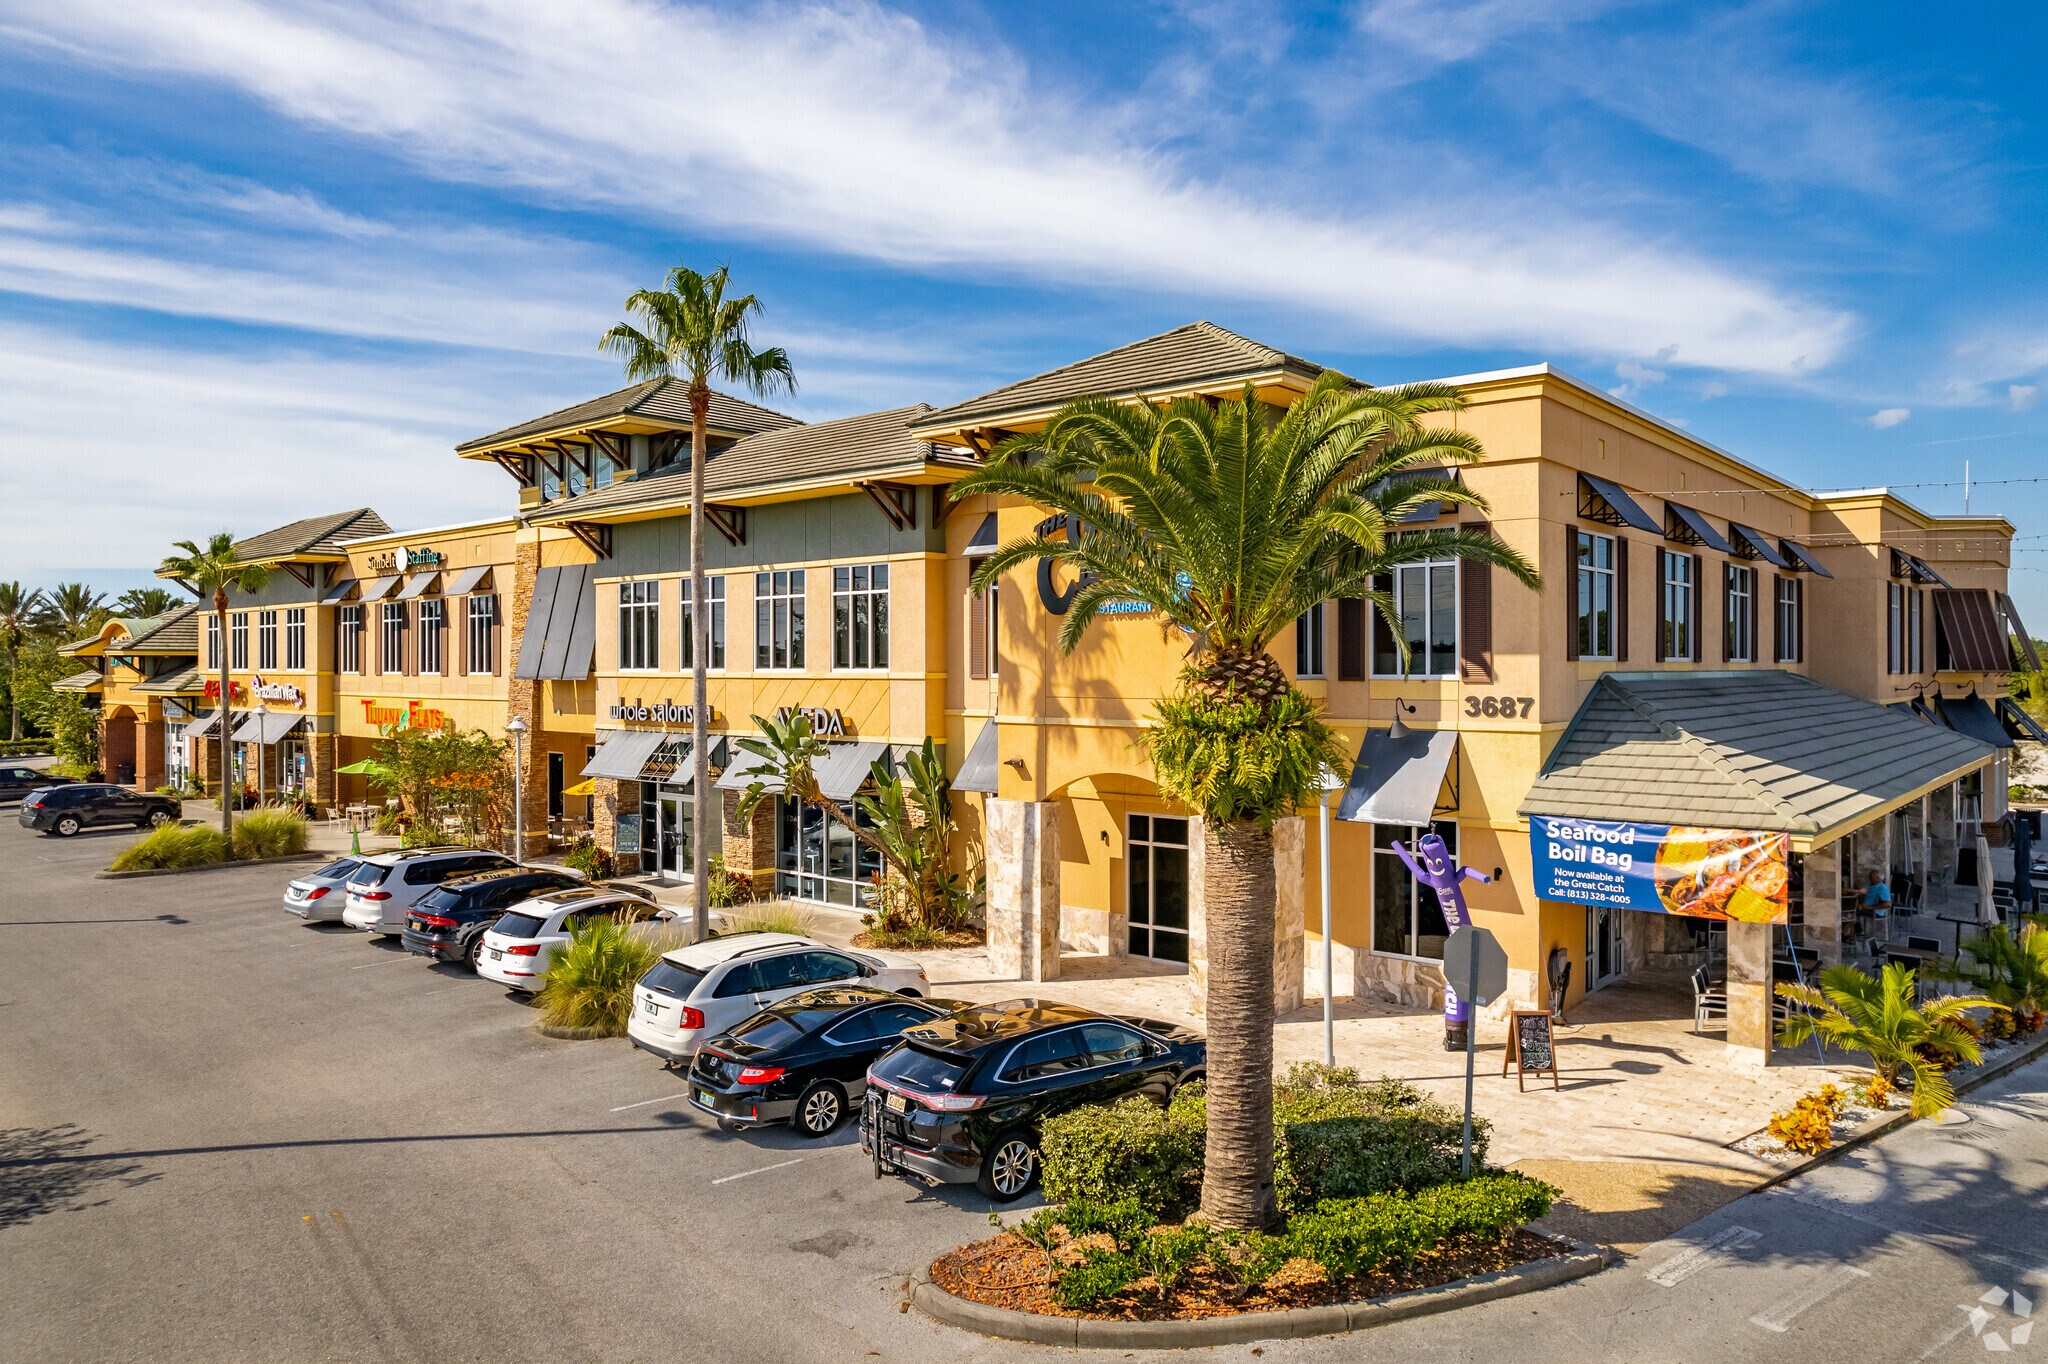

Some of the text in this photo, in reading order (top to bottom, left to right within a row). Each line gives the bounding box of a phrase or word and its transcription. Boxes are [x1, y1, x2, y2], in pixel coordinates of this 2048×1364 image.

[368, 548, 438, 569] Sunbelt Staffing
[361, 699, 441, 729] TIJUANA FLATS
[610, 697, 648, 721] whole
[1464, 696, 1536, 719] 3687
[1546, 820, 1635, 845] Seafood
[1548, 841, 1633, 872] Boil Bag
[1554, 867, 1625, 883] Now available at
[1554, 878, 1625, 893] the Great Catch
[1548, 887, 1631, 904] Call: (813) 328-4005
